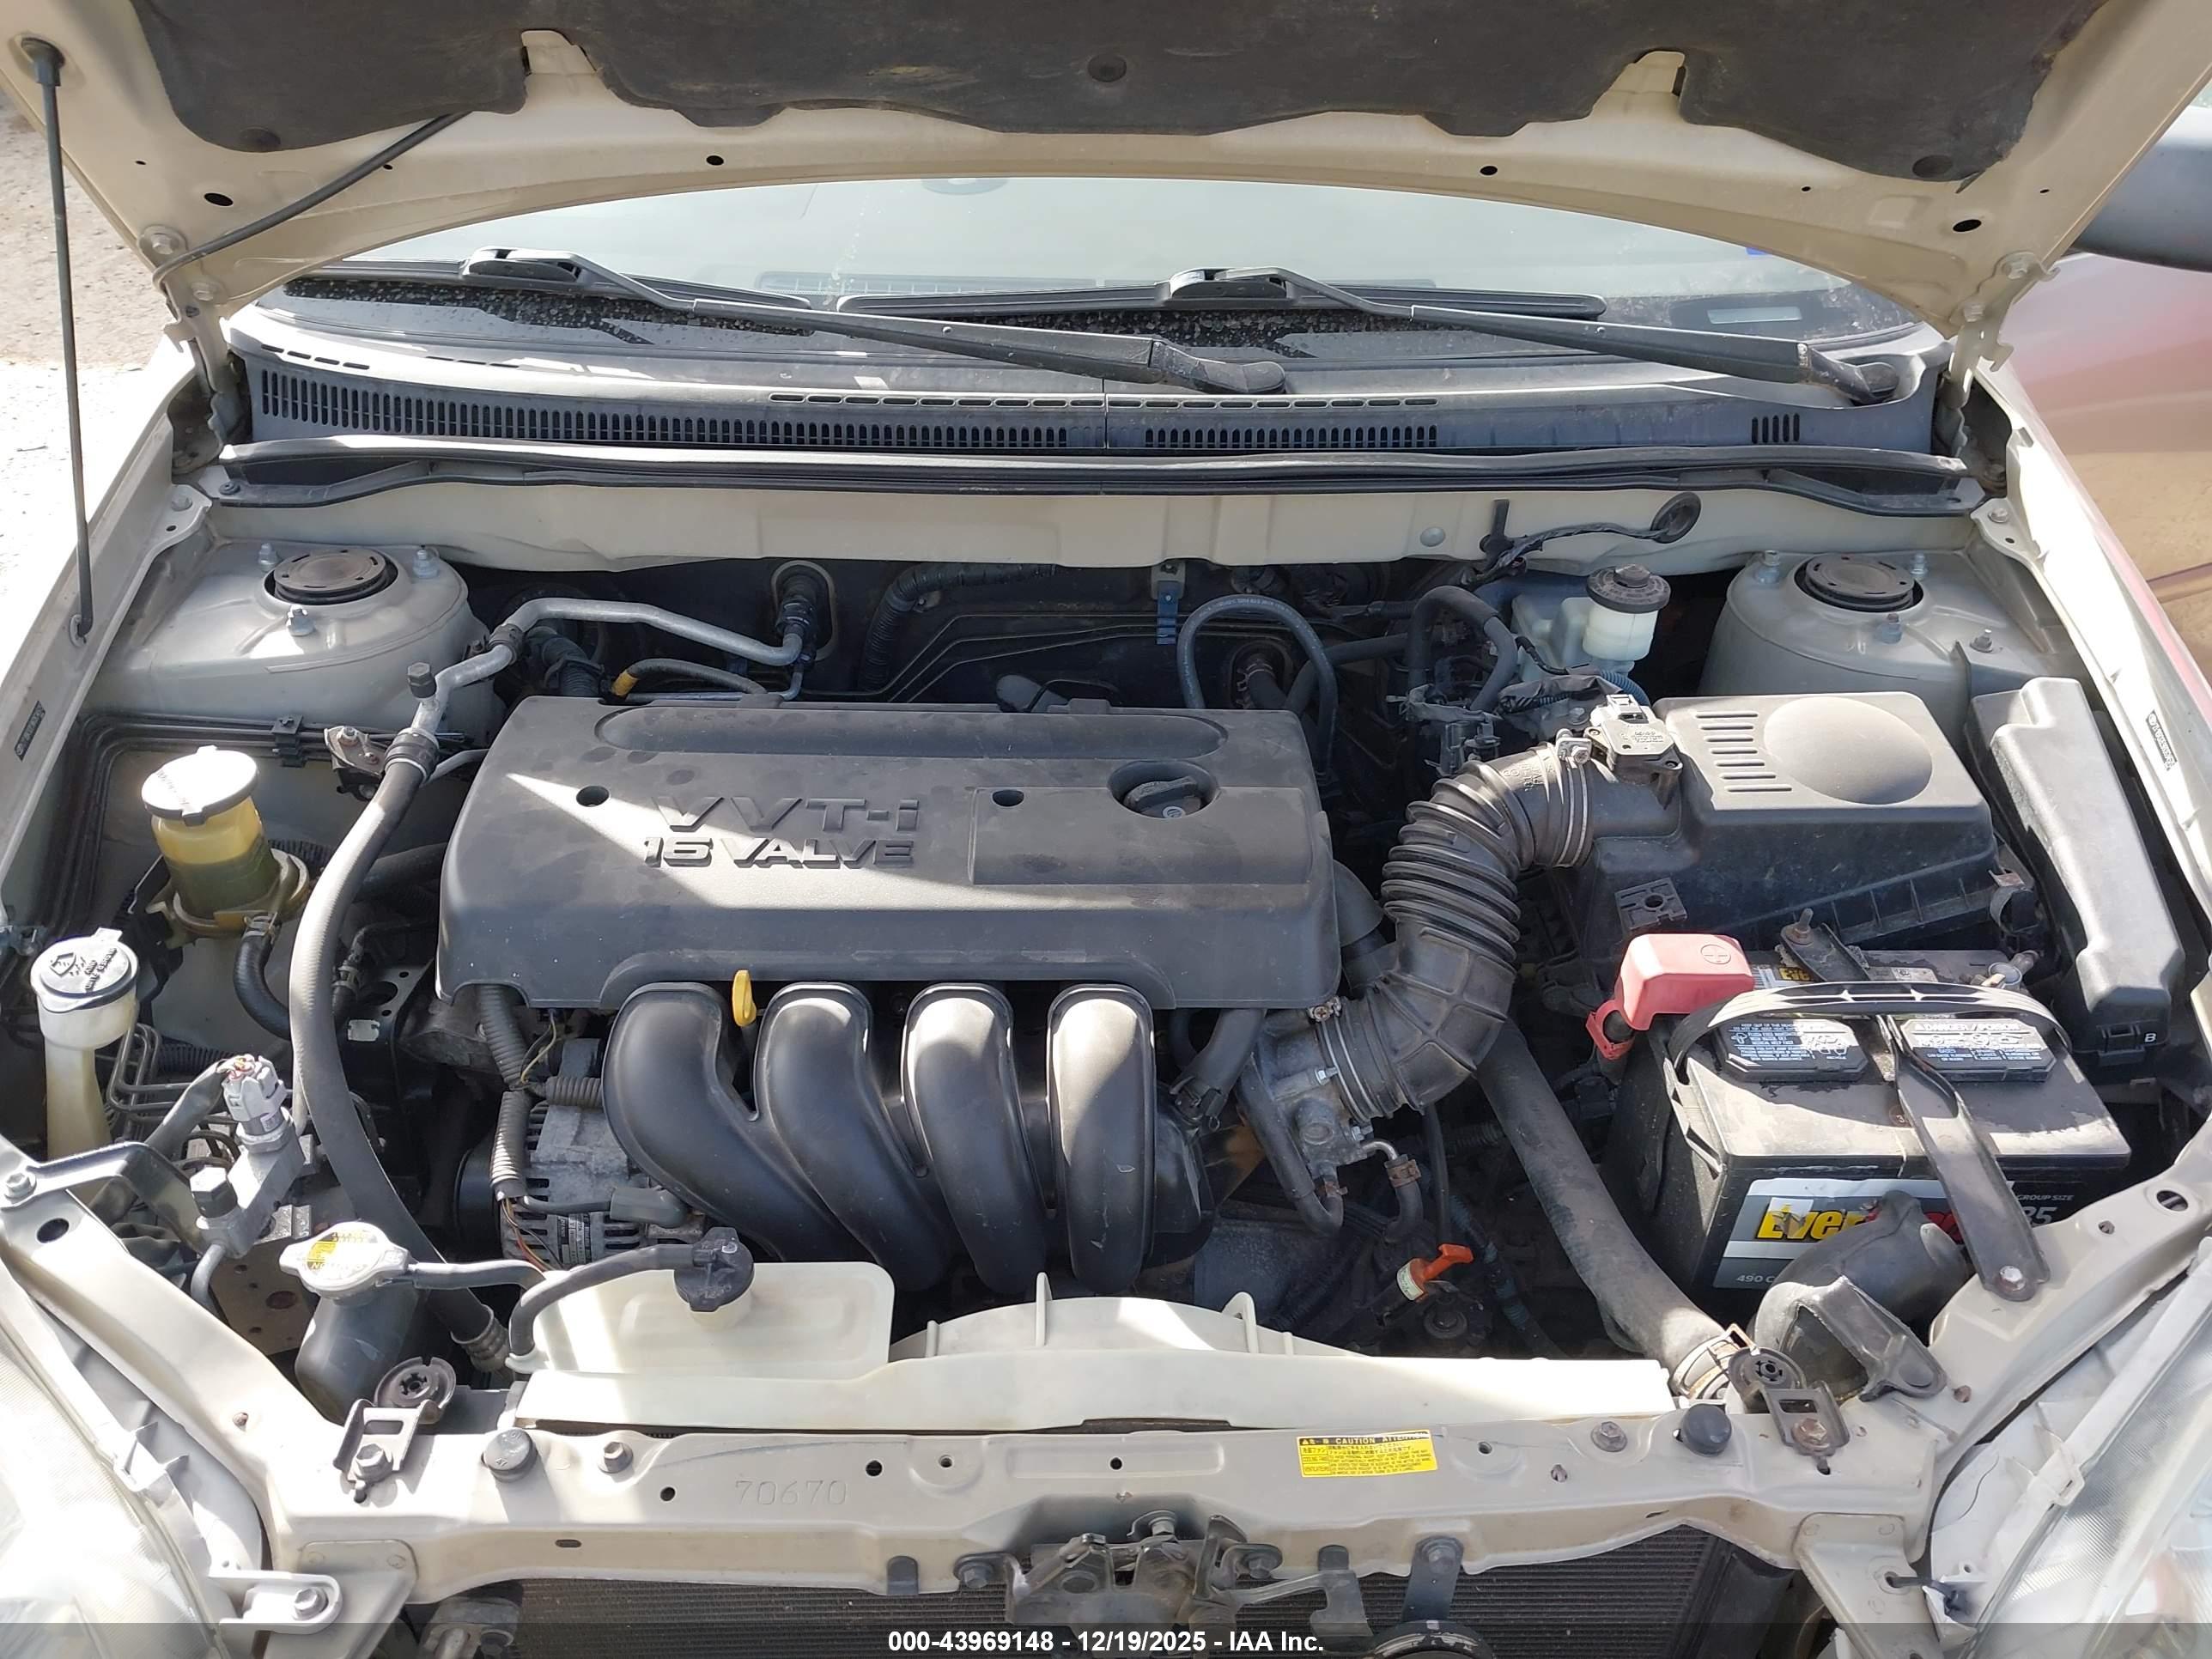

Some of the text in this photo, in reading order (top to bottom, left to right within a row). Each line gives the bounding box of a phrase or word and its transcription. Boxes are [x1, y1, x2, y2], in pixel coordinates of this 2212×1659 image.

[651, 795, 919, 833] VVT-i
[644, 836, 914, 869] 16 VALVE
[2144, 1032, 2156, 1042] B
[1735, 1274, 1764, 1283] 490
[735, 1480, 848, 1505] 70670
